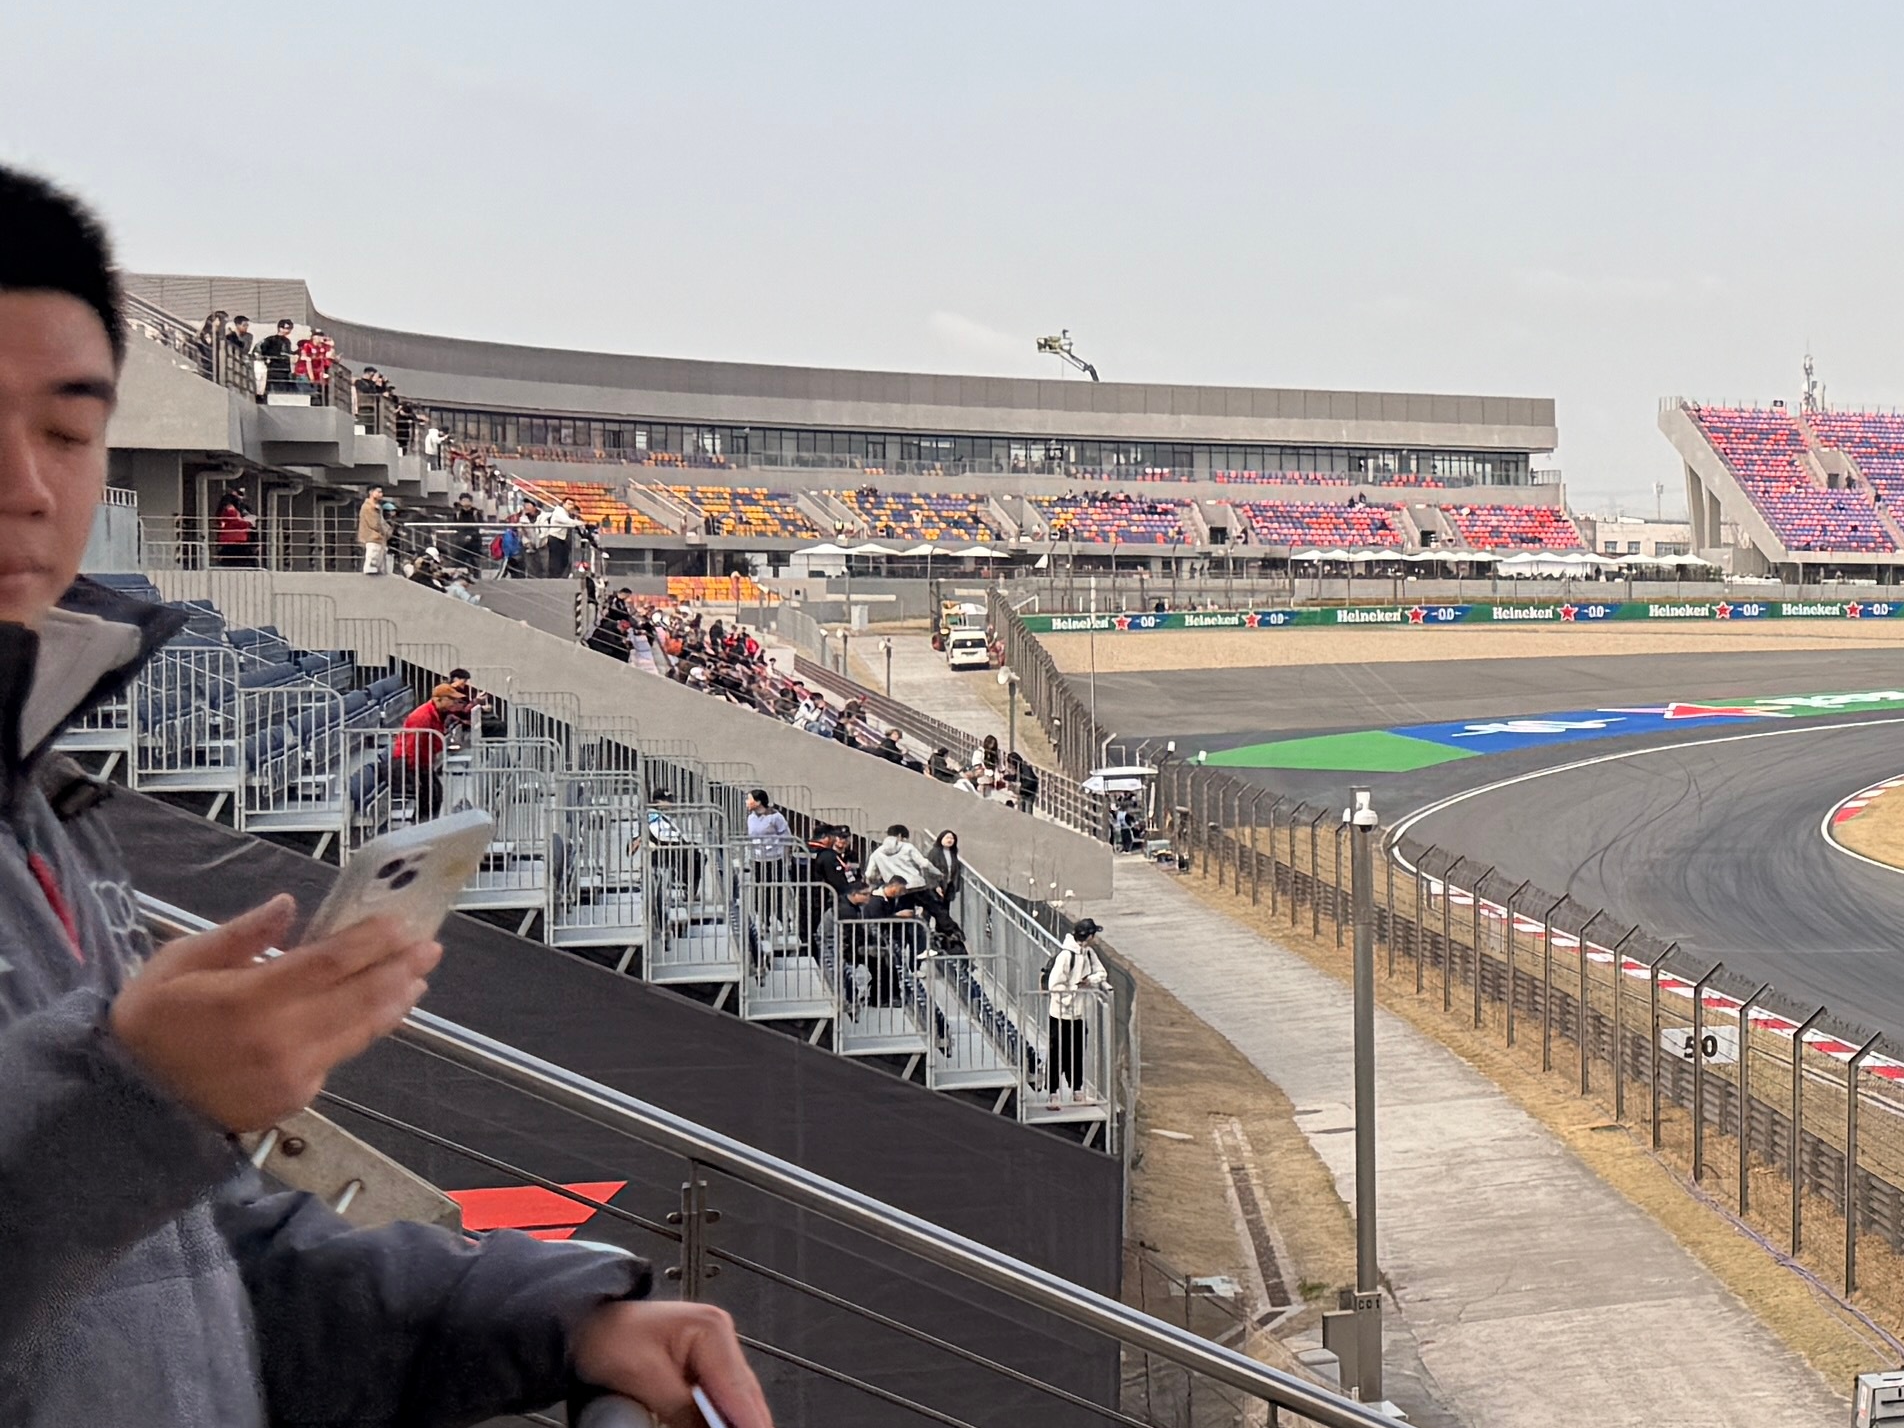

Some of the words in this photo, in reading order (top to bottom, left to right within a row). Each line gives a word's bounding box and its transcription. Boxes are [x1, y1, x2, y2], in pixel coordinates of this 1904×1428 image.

[1337, 608, 1402, 622] Heineken
[1493, 606, 1553, 619] Heineken
[1649, 604, 1709, 617] Heineken
[1782, 604, 1840, 616] Heineken
